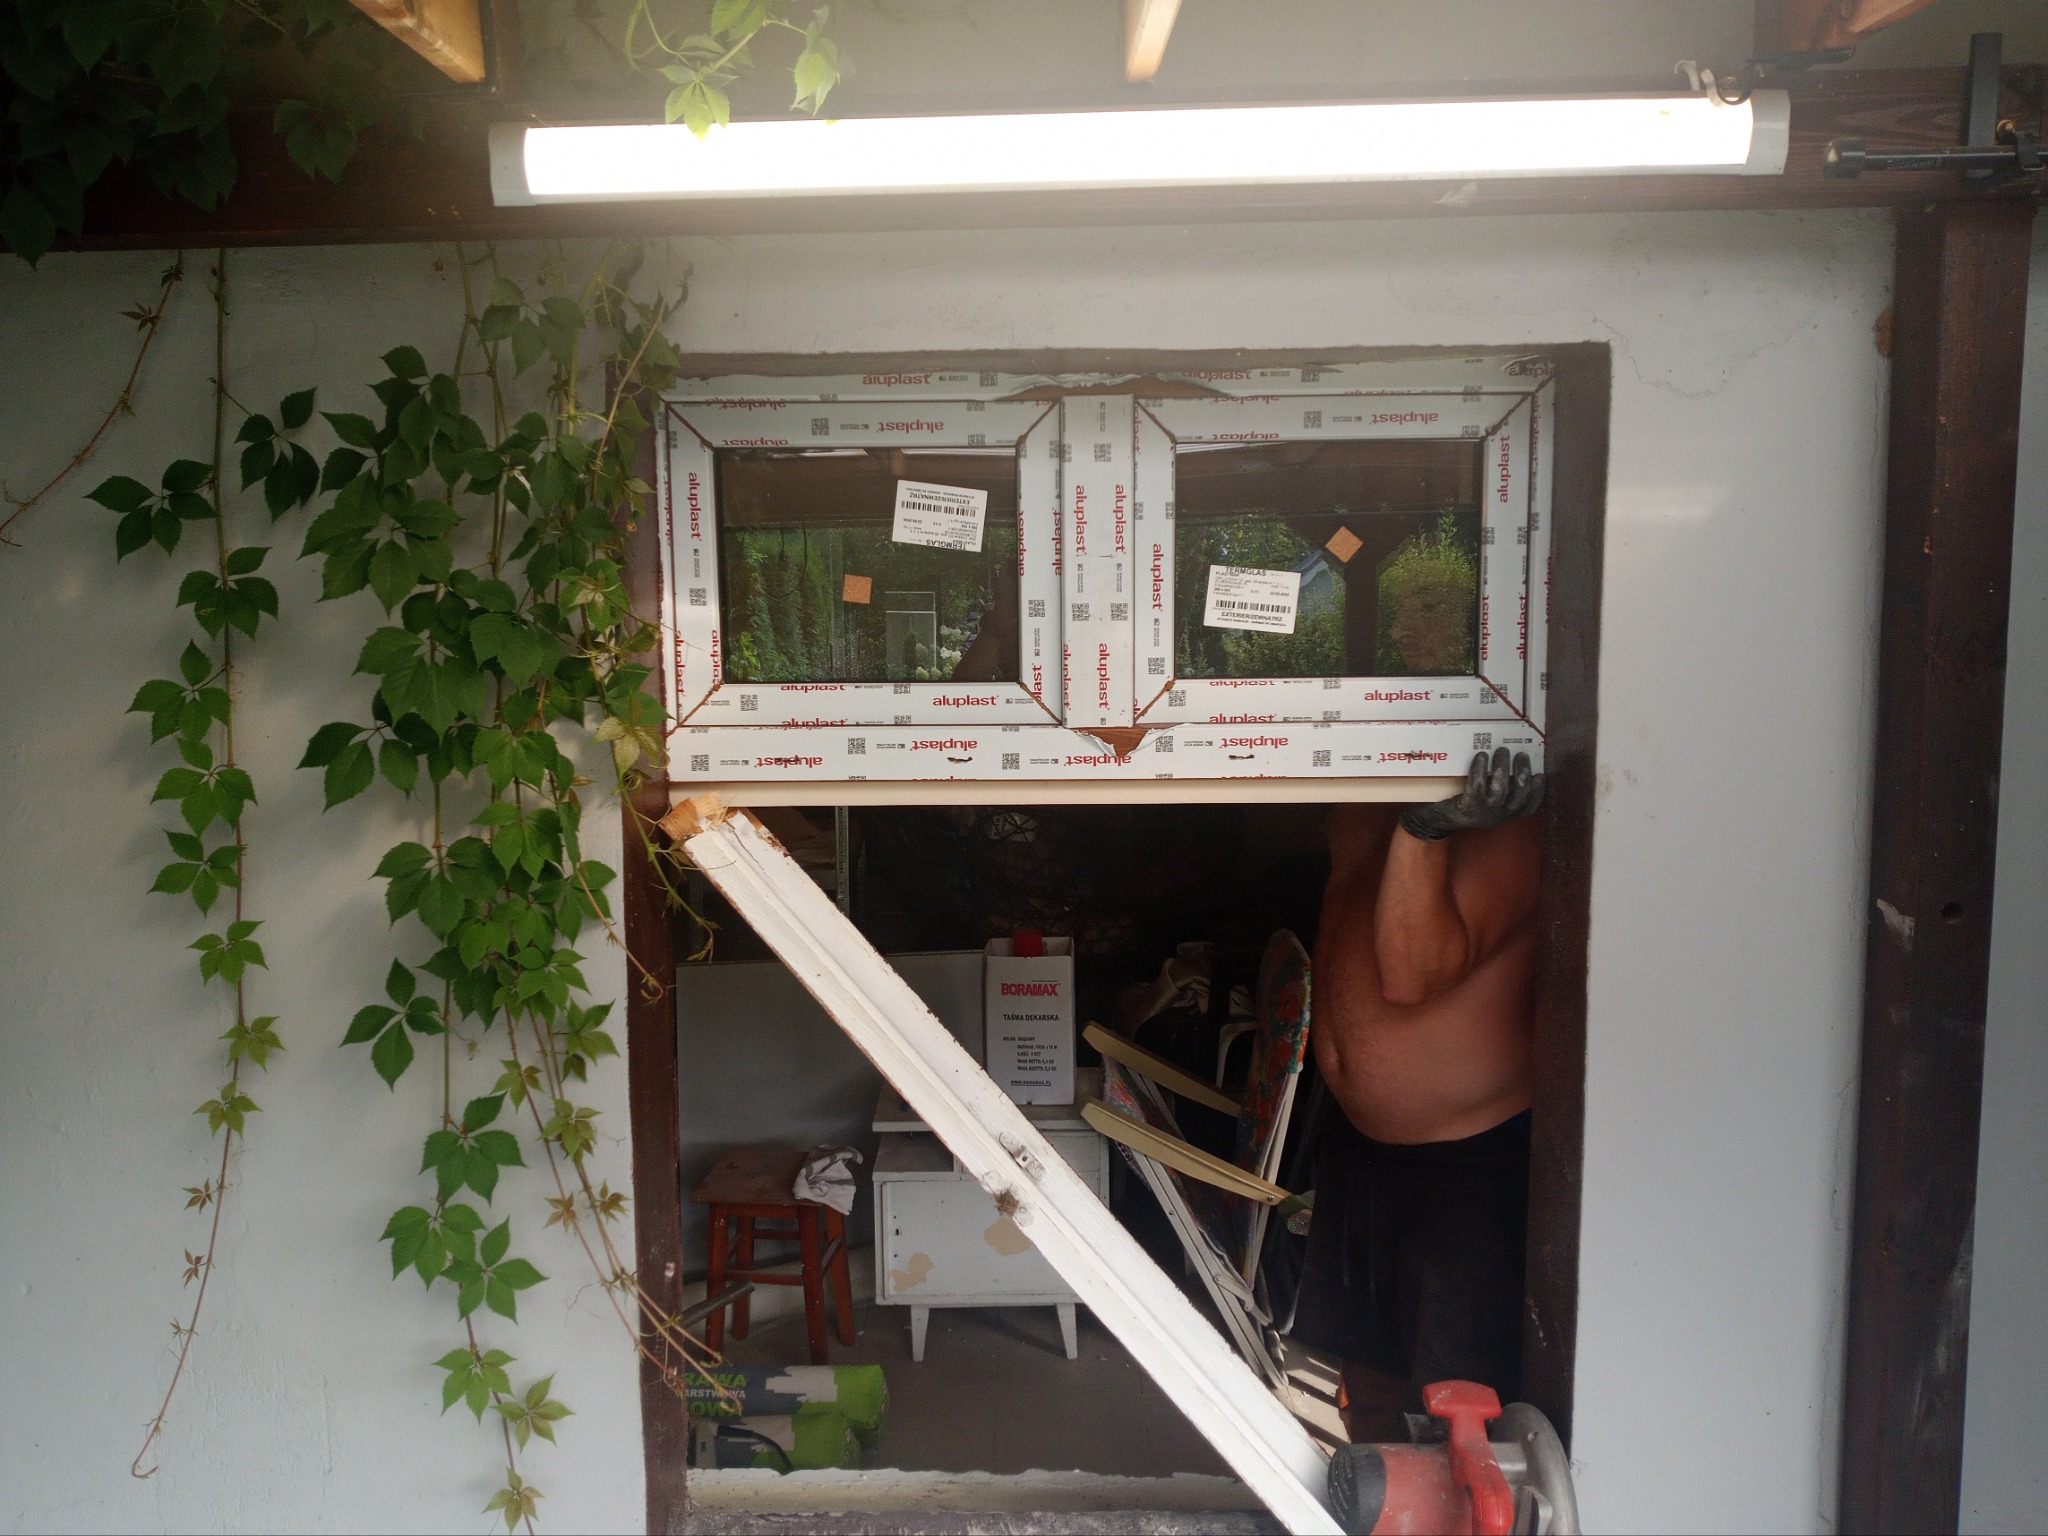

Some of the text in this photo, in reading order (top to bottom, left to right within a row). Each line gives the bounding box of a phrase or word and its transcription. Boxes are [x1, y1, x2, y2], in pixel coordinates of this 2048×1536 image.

[1370, 411, 1439, 425] aluplast
[877, 420, 944, 433] aluplast
[1497, 435, 1511, 503] aluplast
[688, 472, 701, 540] aluplast
[1074, 484, 1088, 554] aluplast
[1113, 484, 1127, 553] aluplast
[1151, 543, 1164, 610] aluplast
[1226, 566, 1267, 577] TERMGLAS
[1480, 595, 1491, 660] aluplast
[1097, 643, 1110, 708] aluplast
[933, 695, 997, 708] aluplast
[1364, 690, 1432, 703] aluplast
[911, 739, 977, 751] aluplast
[1221, 736, 1288, 748] aluplast
[756, 755, 823, 768] aluplast
[1065, 755, 1132, 767] aluplast
[1378, 750, 1448, 764] aluplast
[1001, 983, 1059, 996] BORAMAX
[1003, 1013, 1024, 1021] TAŚMA
